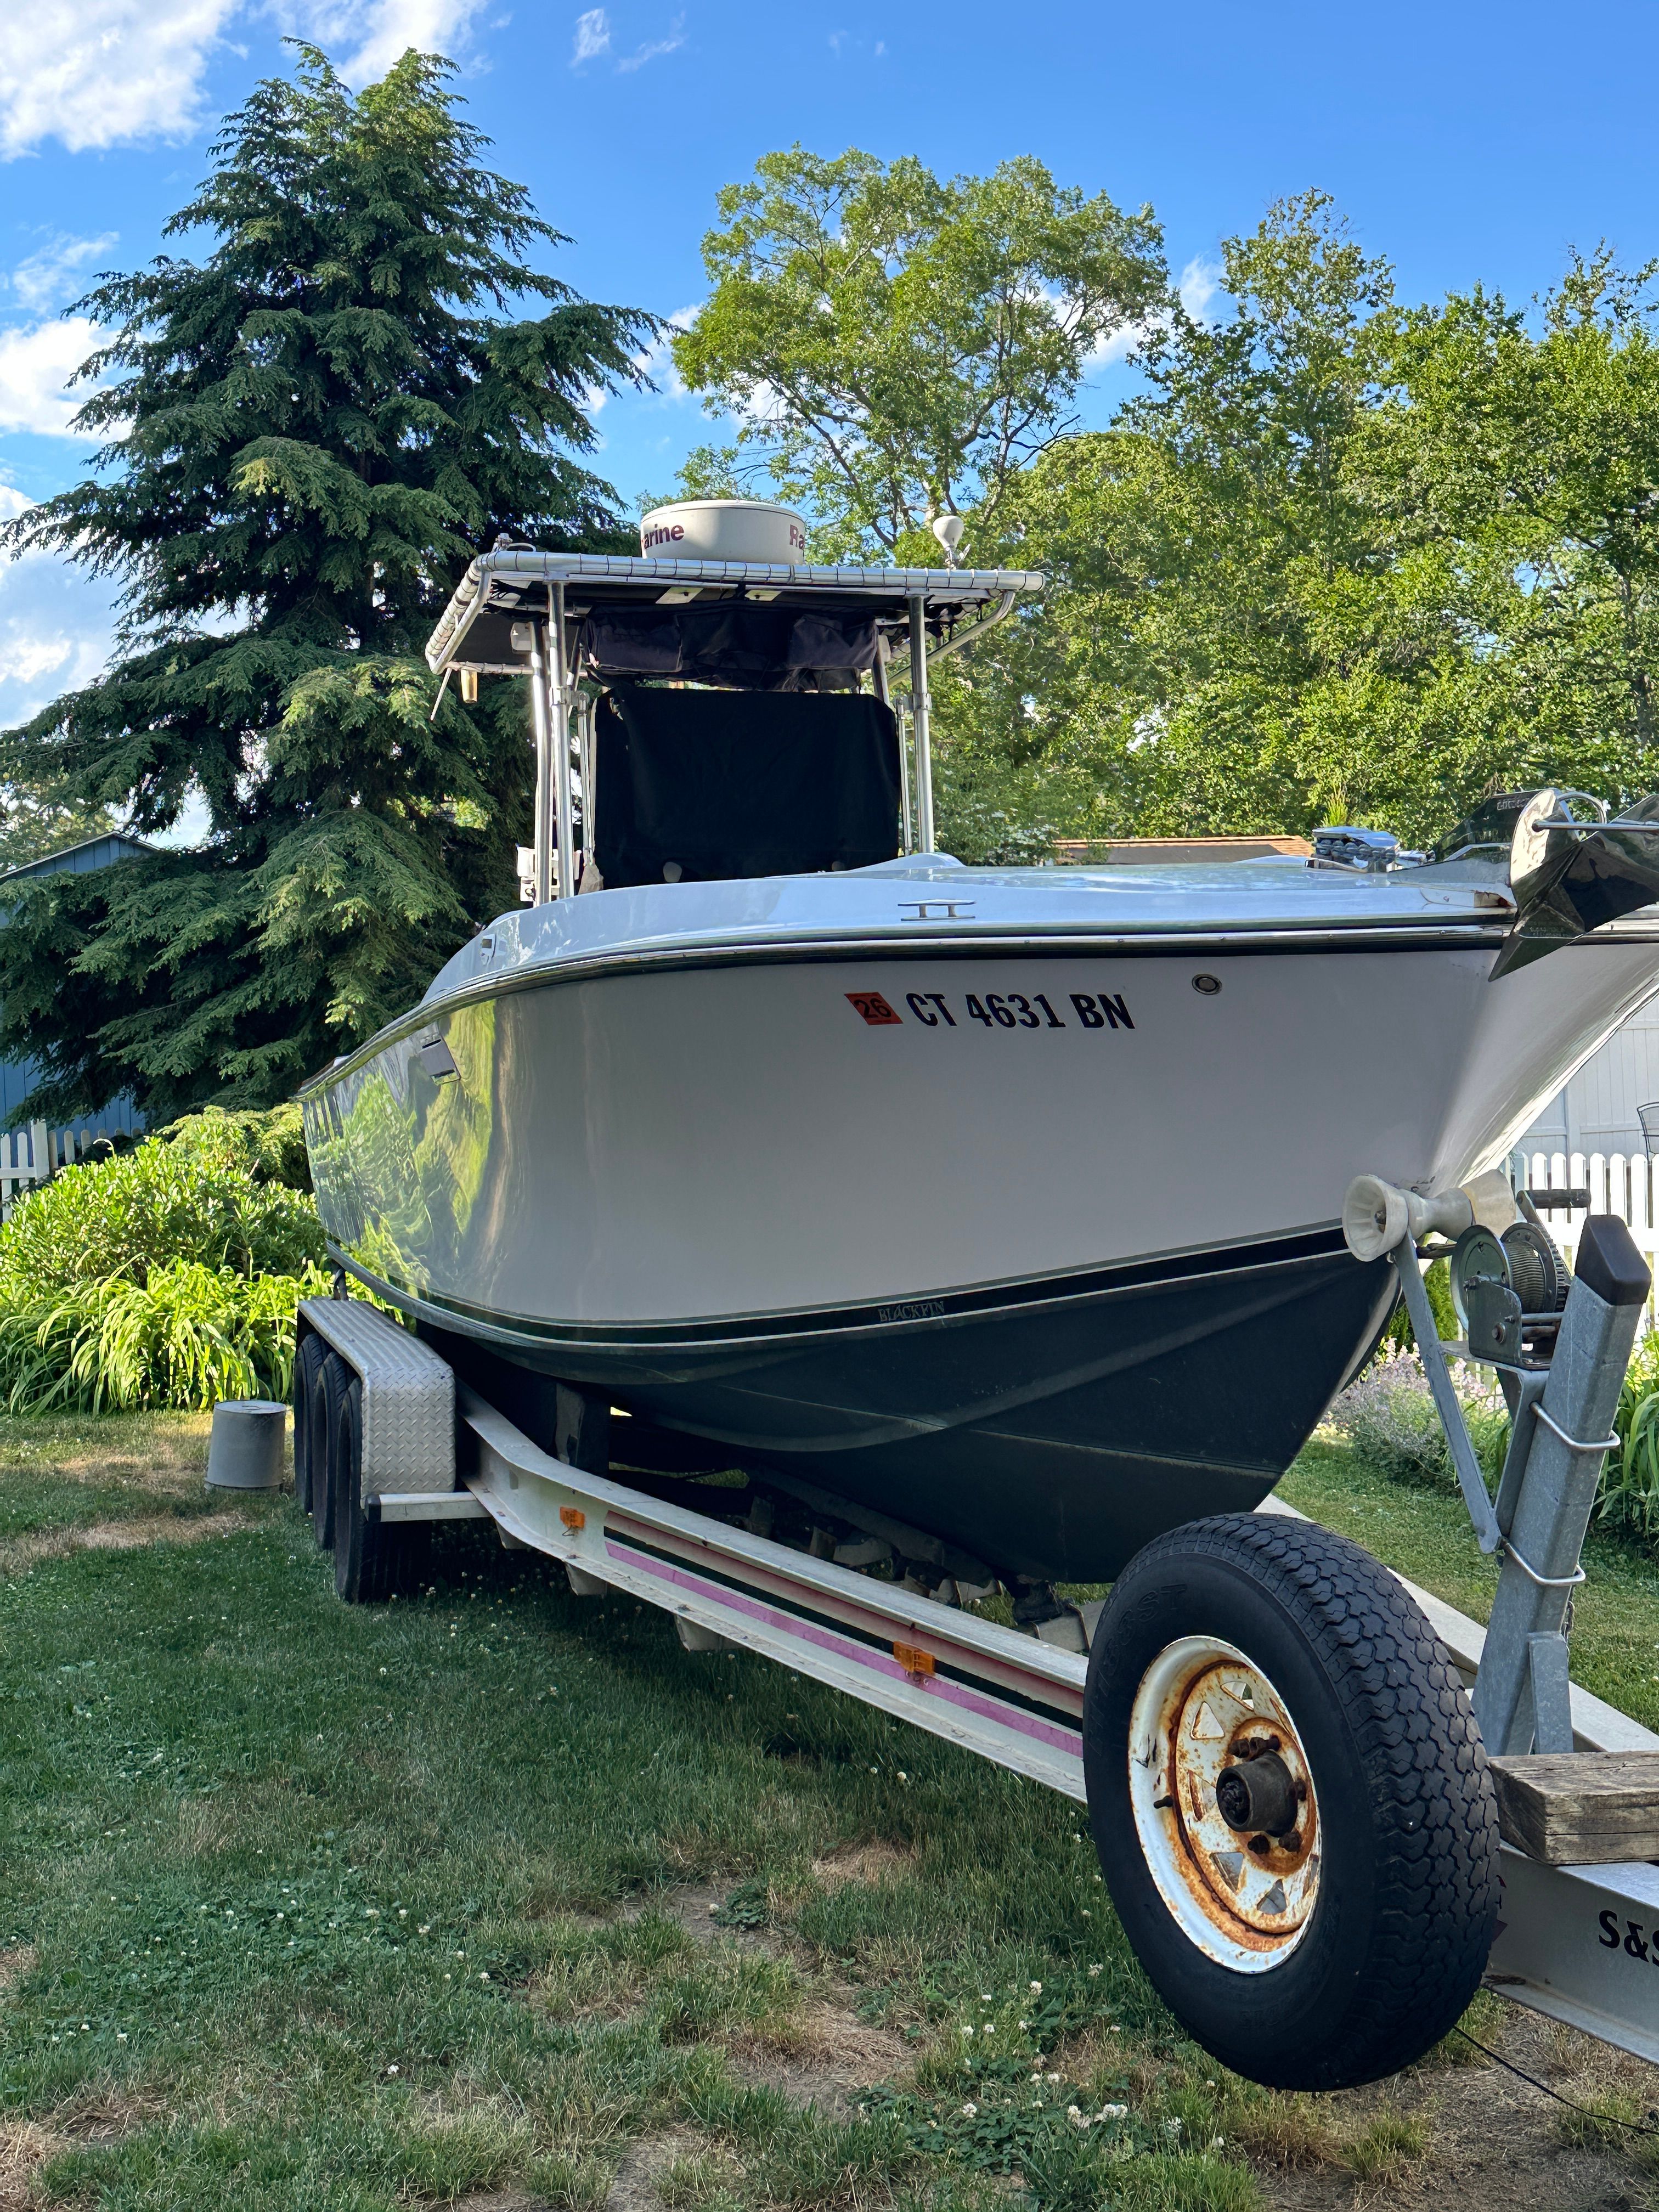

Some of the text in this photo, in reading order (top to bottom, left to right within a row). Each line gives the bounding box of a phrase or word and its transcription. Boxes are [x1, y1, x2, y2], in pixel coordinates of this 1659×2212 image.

[642, 523, 684, 549] arine
[789, 524, 805, 550] Ra
[854, 998, 891, 1018] 26
[906, 993, 1135, 1029] CT 4631 BN
